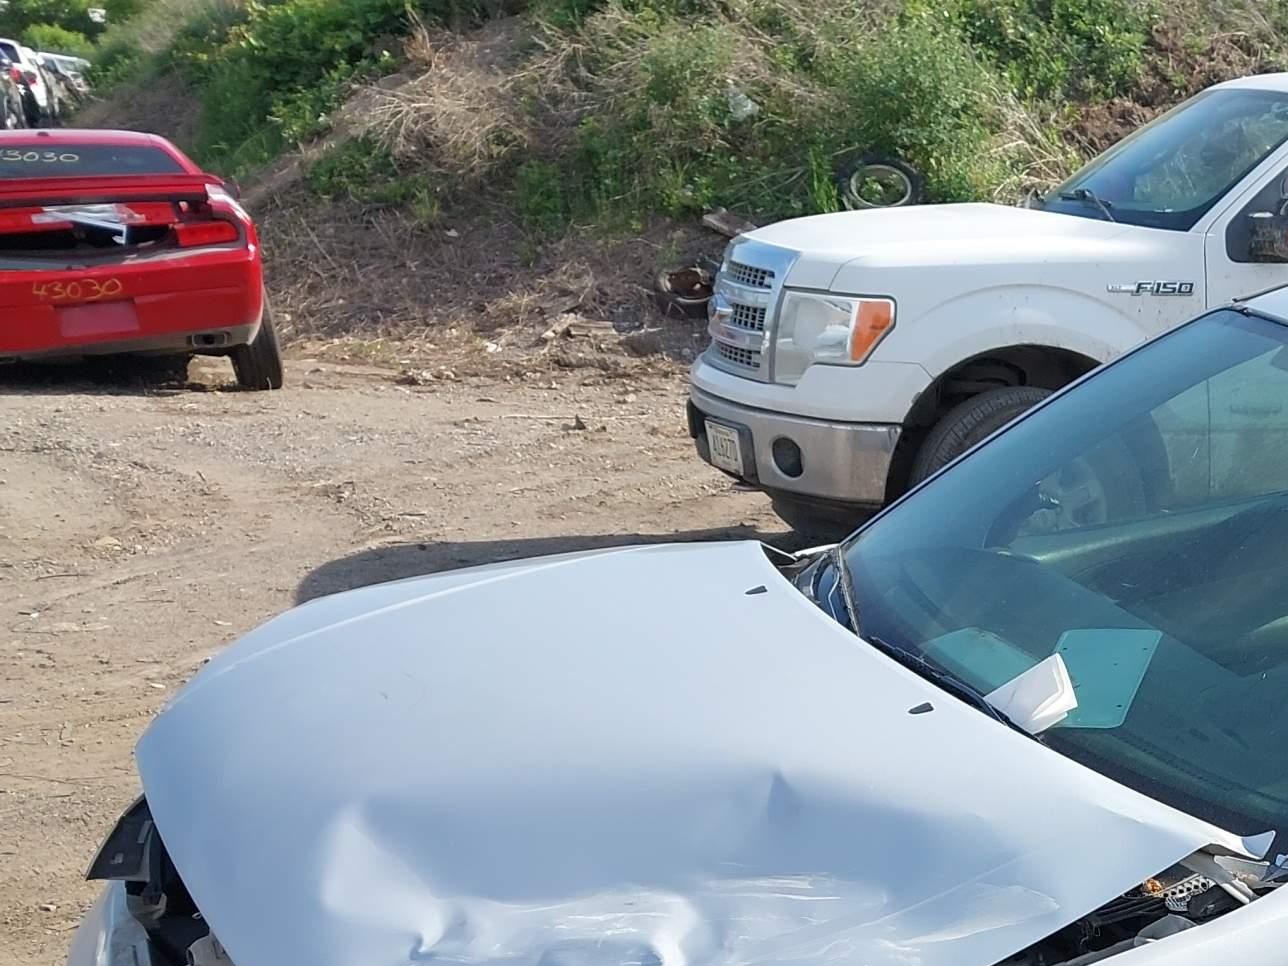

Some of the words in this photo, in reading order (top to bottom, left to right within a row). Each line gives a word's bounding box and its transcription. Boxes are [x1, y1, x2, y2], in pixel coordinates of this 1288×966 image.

[0, 150, 79, 161] 3030
[32, 278, 122, 300] 43030
[1134, 280, 1195, 296] F-150
